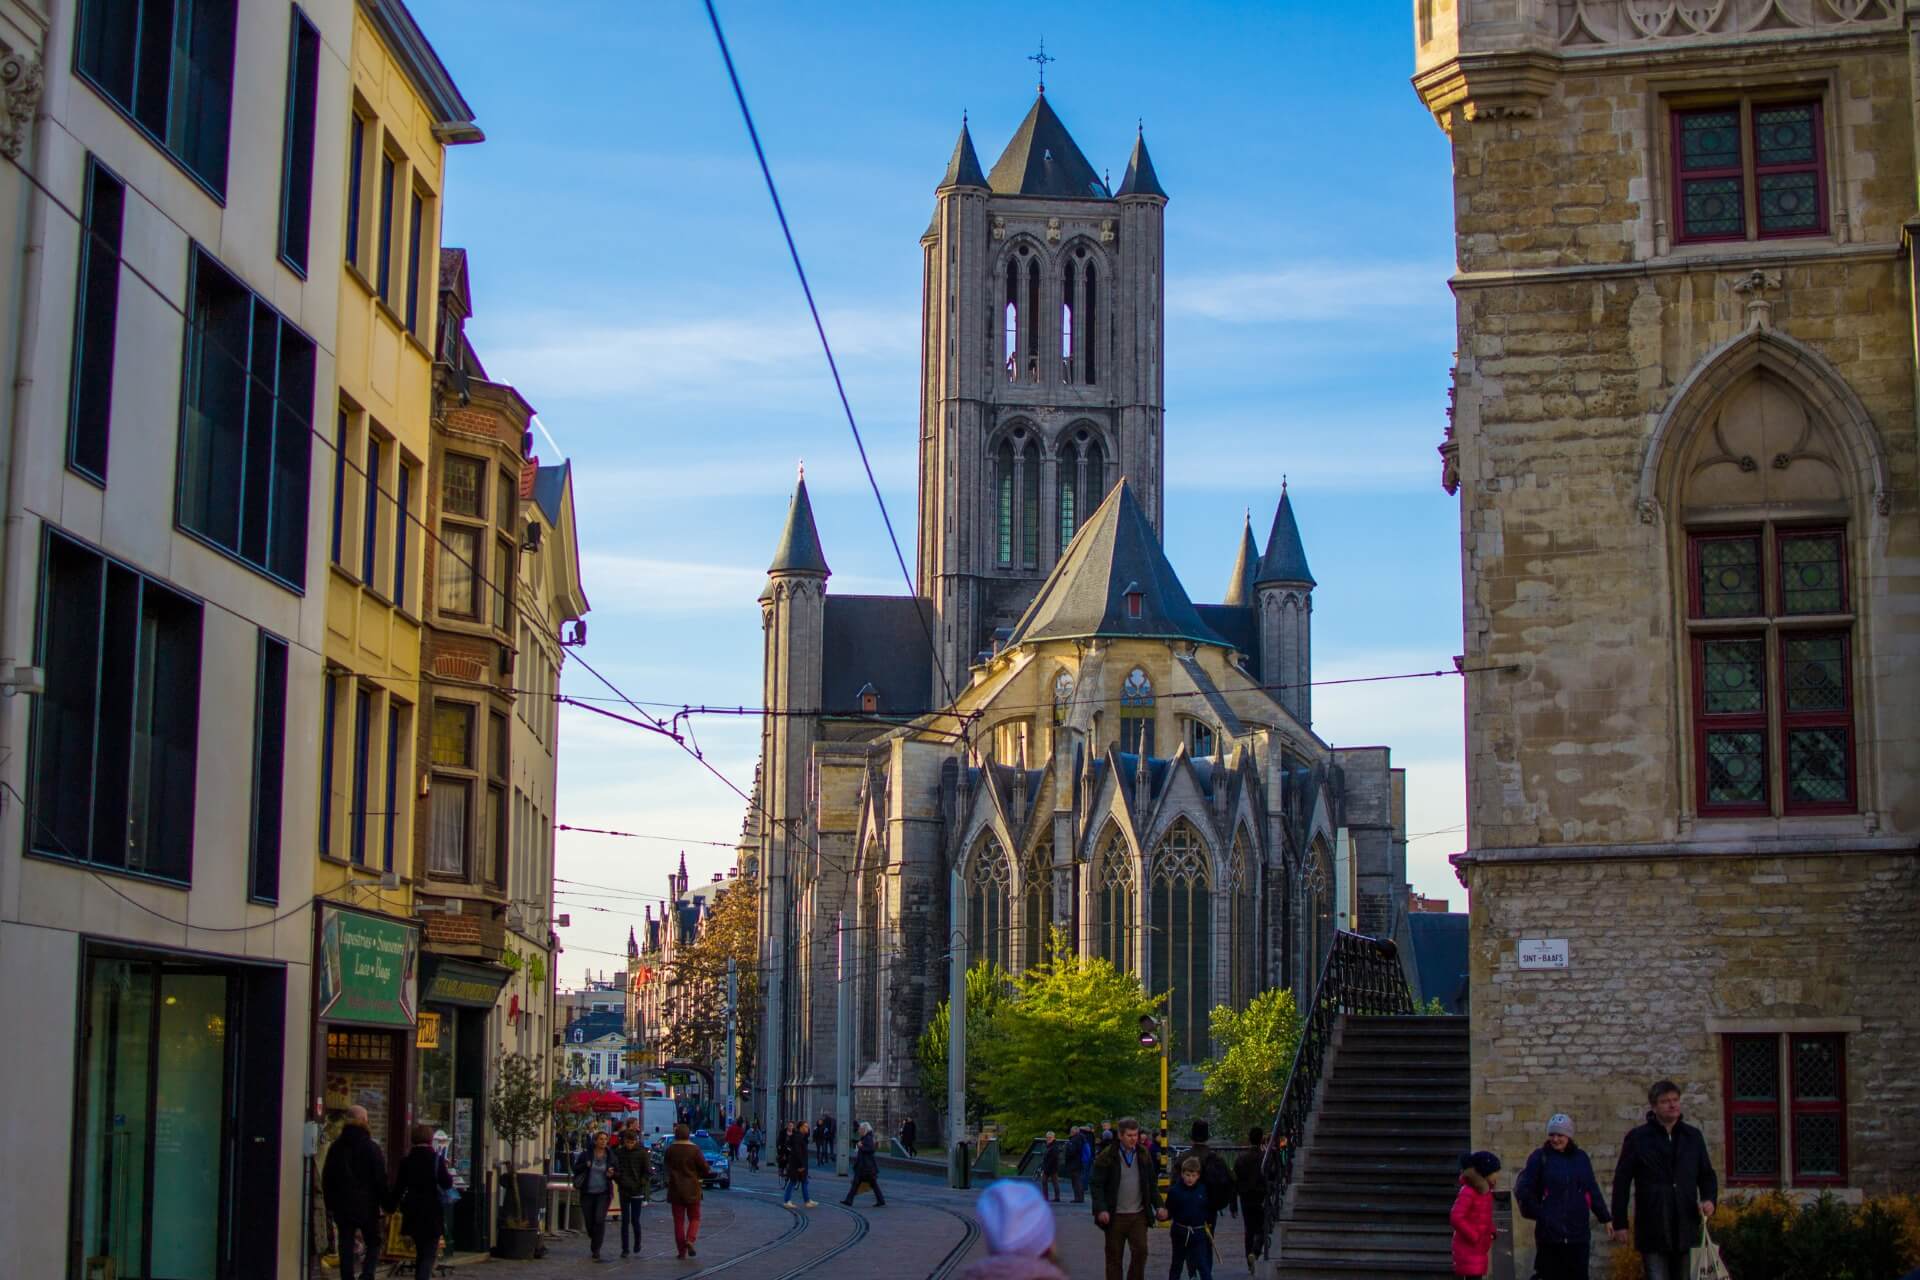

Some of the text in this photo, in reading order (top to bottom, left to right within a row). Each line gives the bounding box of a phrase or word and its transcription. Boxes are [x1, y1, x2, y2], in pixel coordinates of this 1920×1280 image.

[340, 921, 405, 956] Tapestries Souvenirs
[354, 953, 390, 984] Lace Bags
